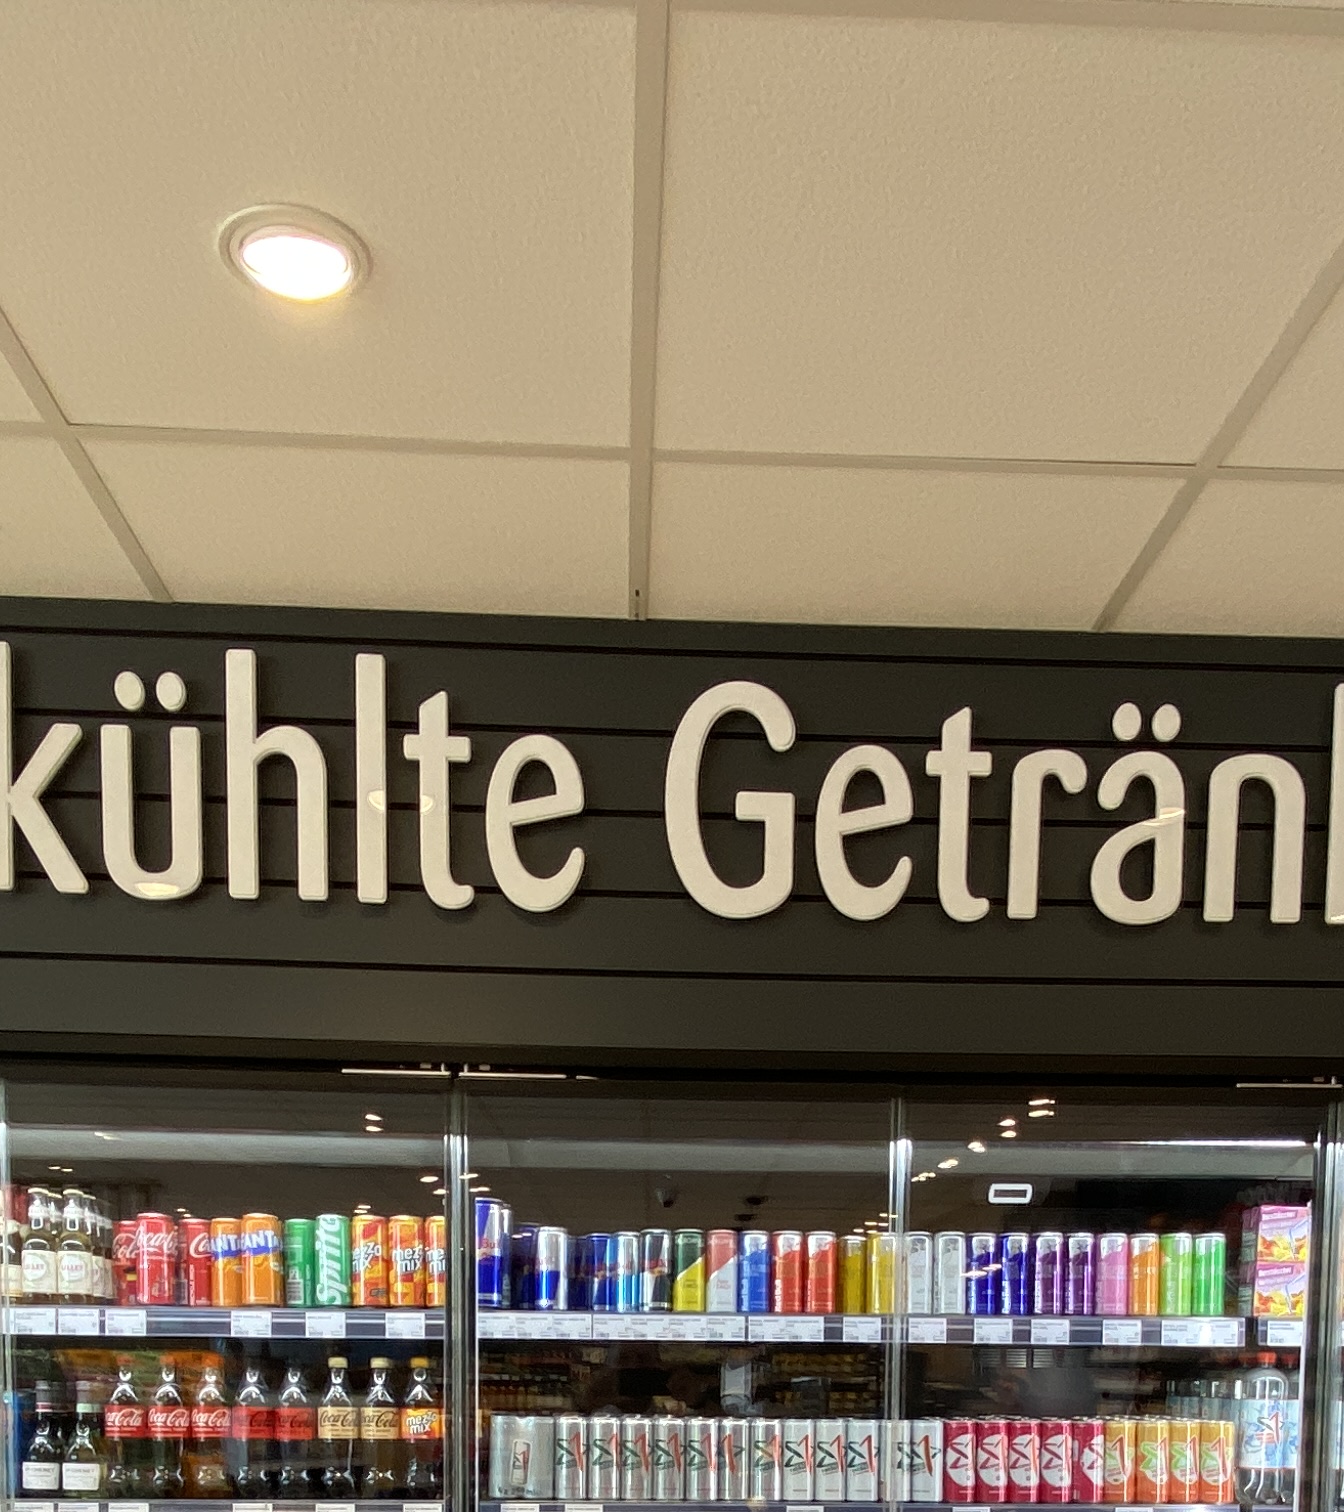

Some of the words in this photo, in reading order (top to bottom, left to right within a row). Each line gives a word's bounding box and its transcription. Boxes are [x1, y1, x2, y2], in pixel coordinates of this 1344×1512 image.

[316, 1216, 348, 1304] Sprite
[400, 1256, 423, 1274] mix
[429, 1257, 445, 1273] mi
[406, 1411, 438, 1426] mezzo
[409, 1422, 431, 1435] mix
